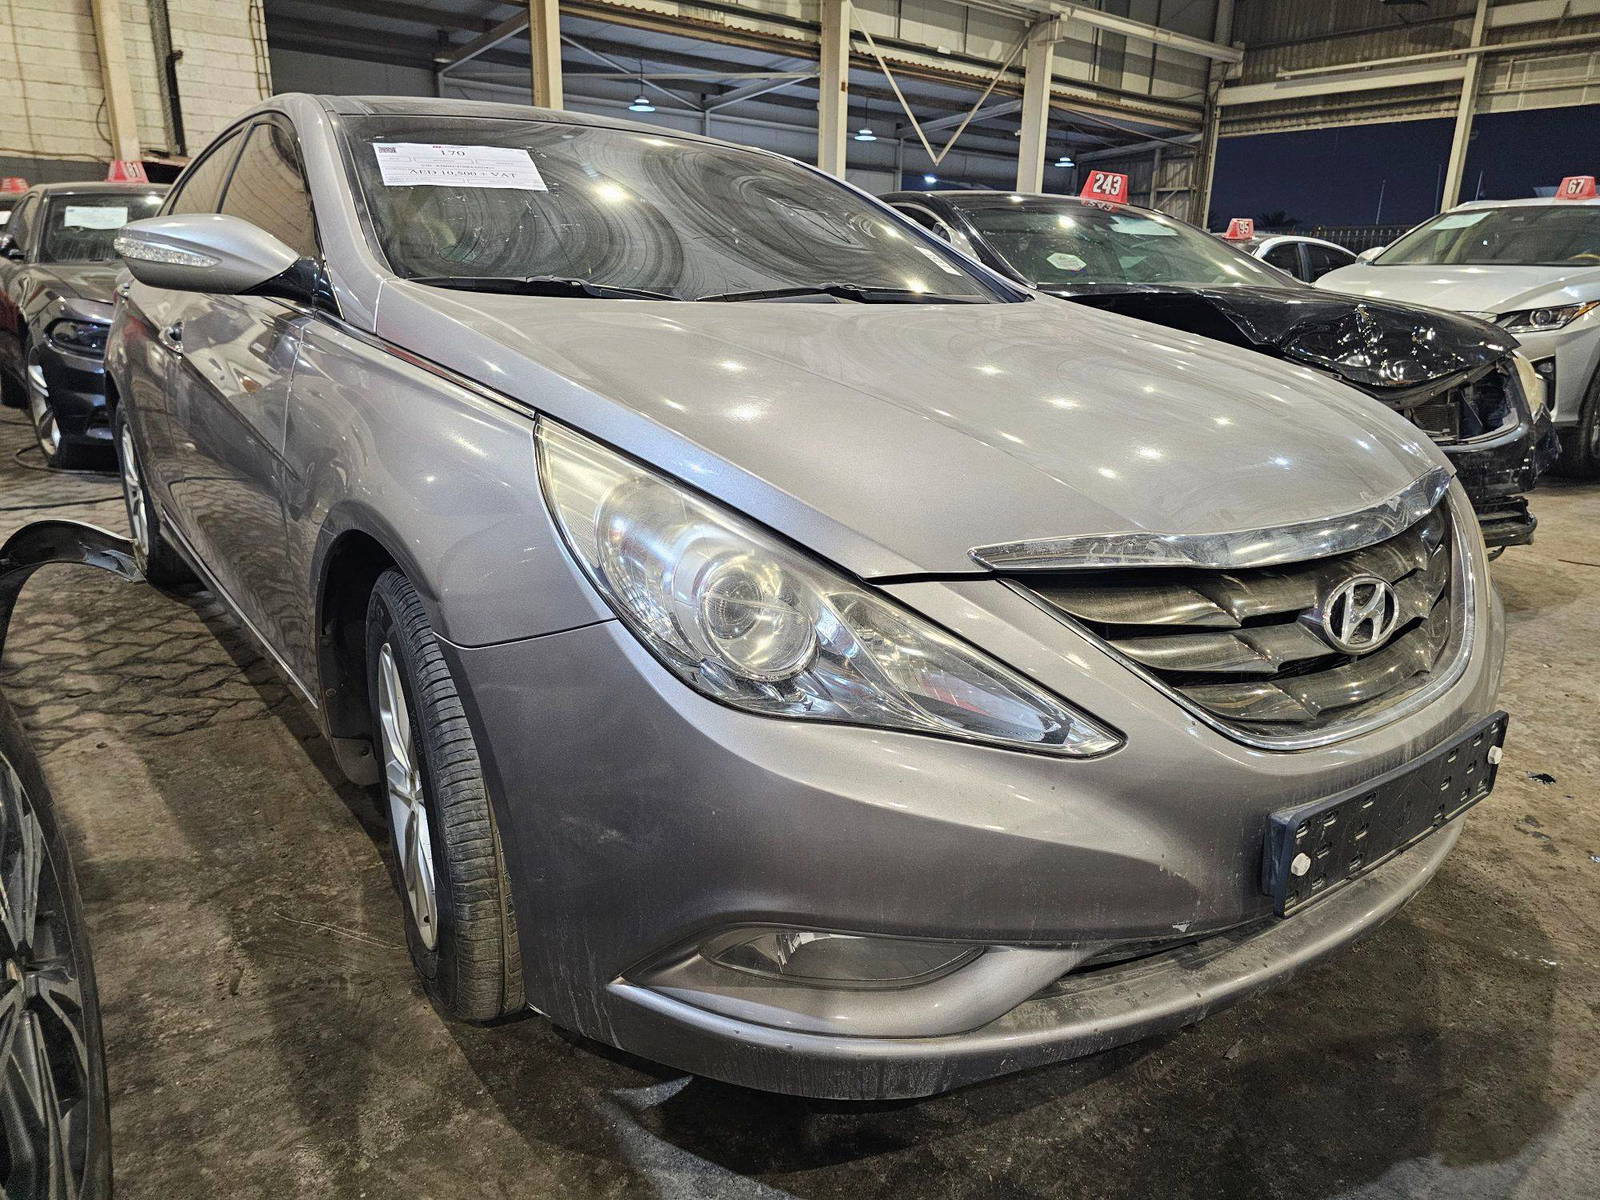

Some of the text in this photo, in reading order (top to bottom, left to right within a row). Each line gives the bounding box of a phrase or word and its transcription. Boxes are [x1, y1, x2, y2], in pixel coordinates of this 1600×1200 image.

[441, 169, 477, 177] 10,500
[1092, 173, 1122, 196] 243
[1567, 179, 1584, 194] 67
